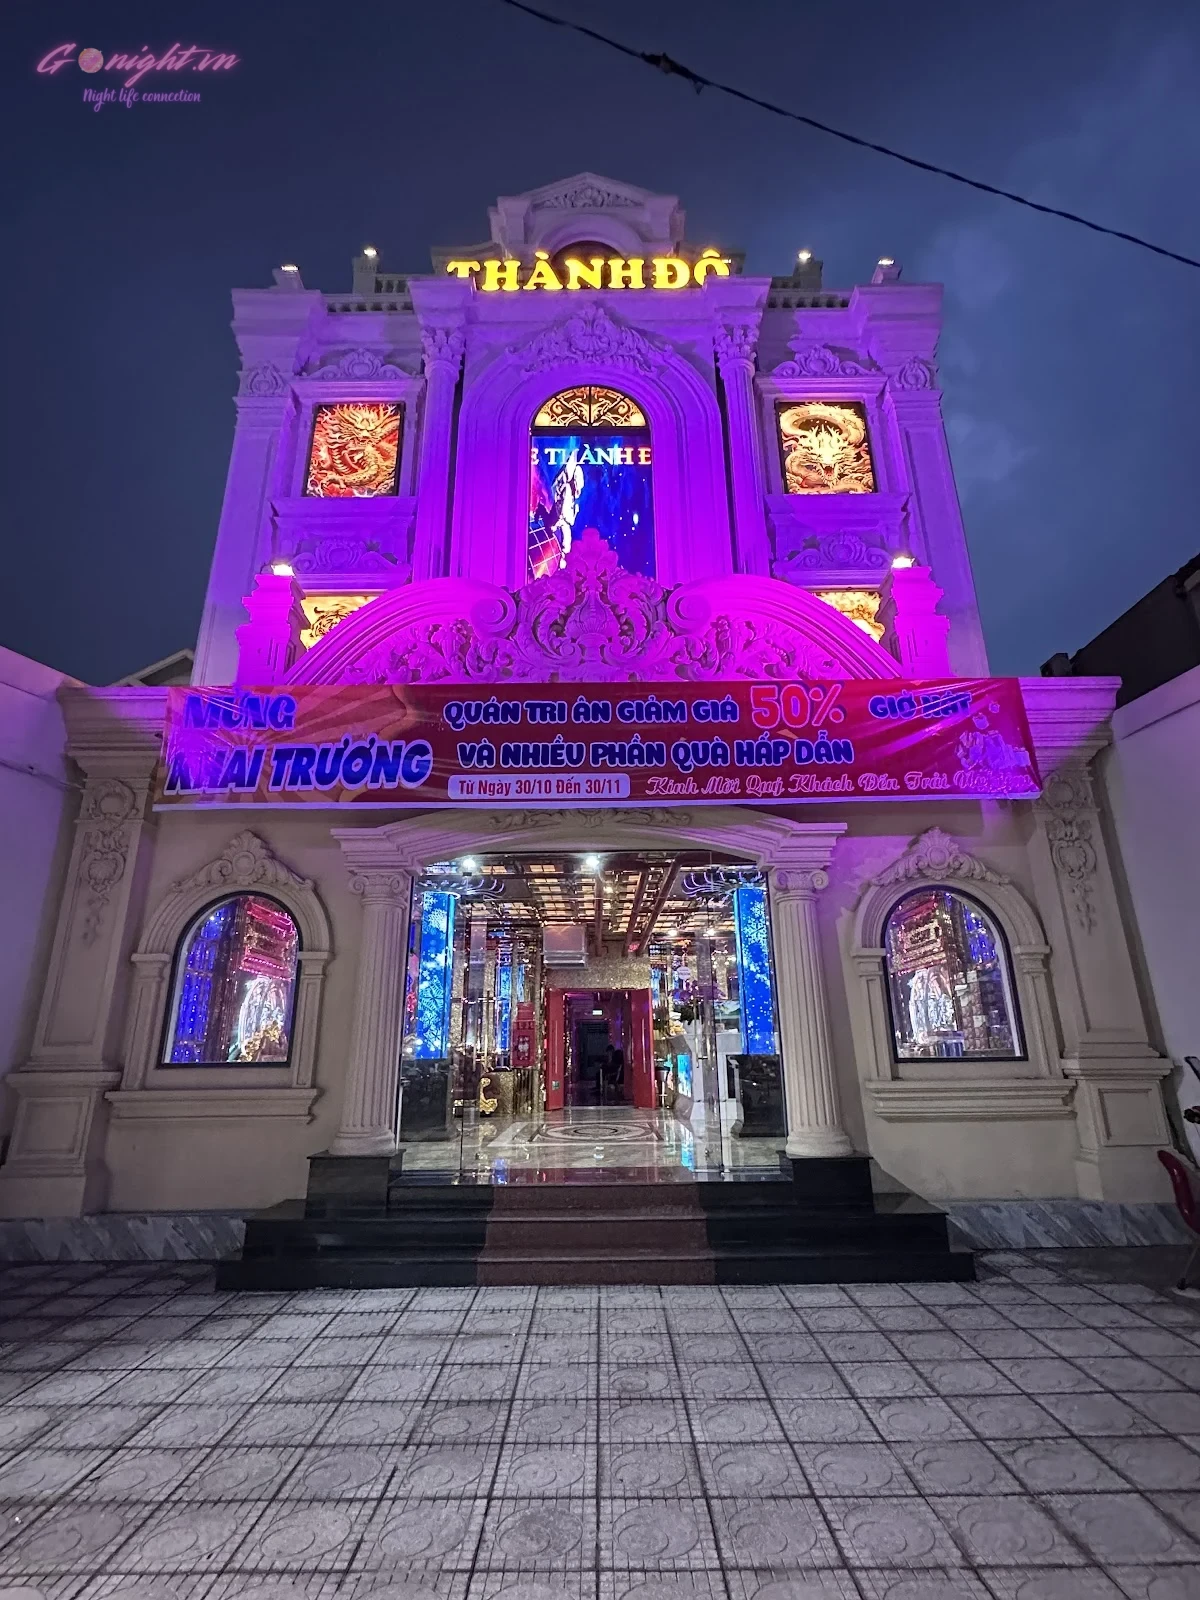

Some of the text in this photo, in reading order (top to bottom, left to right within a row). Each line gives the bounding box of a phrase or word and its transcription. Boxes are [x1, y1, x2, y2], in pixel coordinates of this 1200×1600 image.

[446, 248, 731, 291] THÀNH ĐÔ
[544, 443, 634, 465] THÀNH
[443, 696, 521, 731] QUÁN
[524, 700, 567, 724] TRI
[571, 695, 611, 724] ÂN
[616, 694, 687, 723] GIẢM
[691, 694, 739, 723] GIÁ
[750, 683, 844, 729] 50%
[268, 732, 433, 792] TRƯƠNG
[457, 729, 854, 773] VÀ NHIỀU PHẦN QUÀ HẤP DẪN
[459, 776, 620, 796] Từ Ngày 30/10 Đến 30/11
